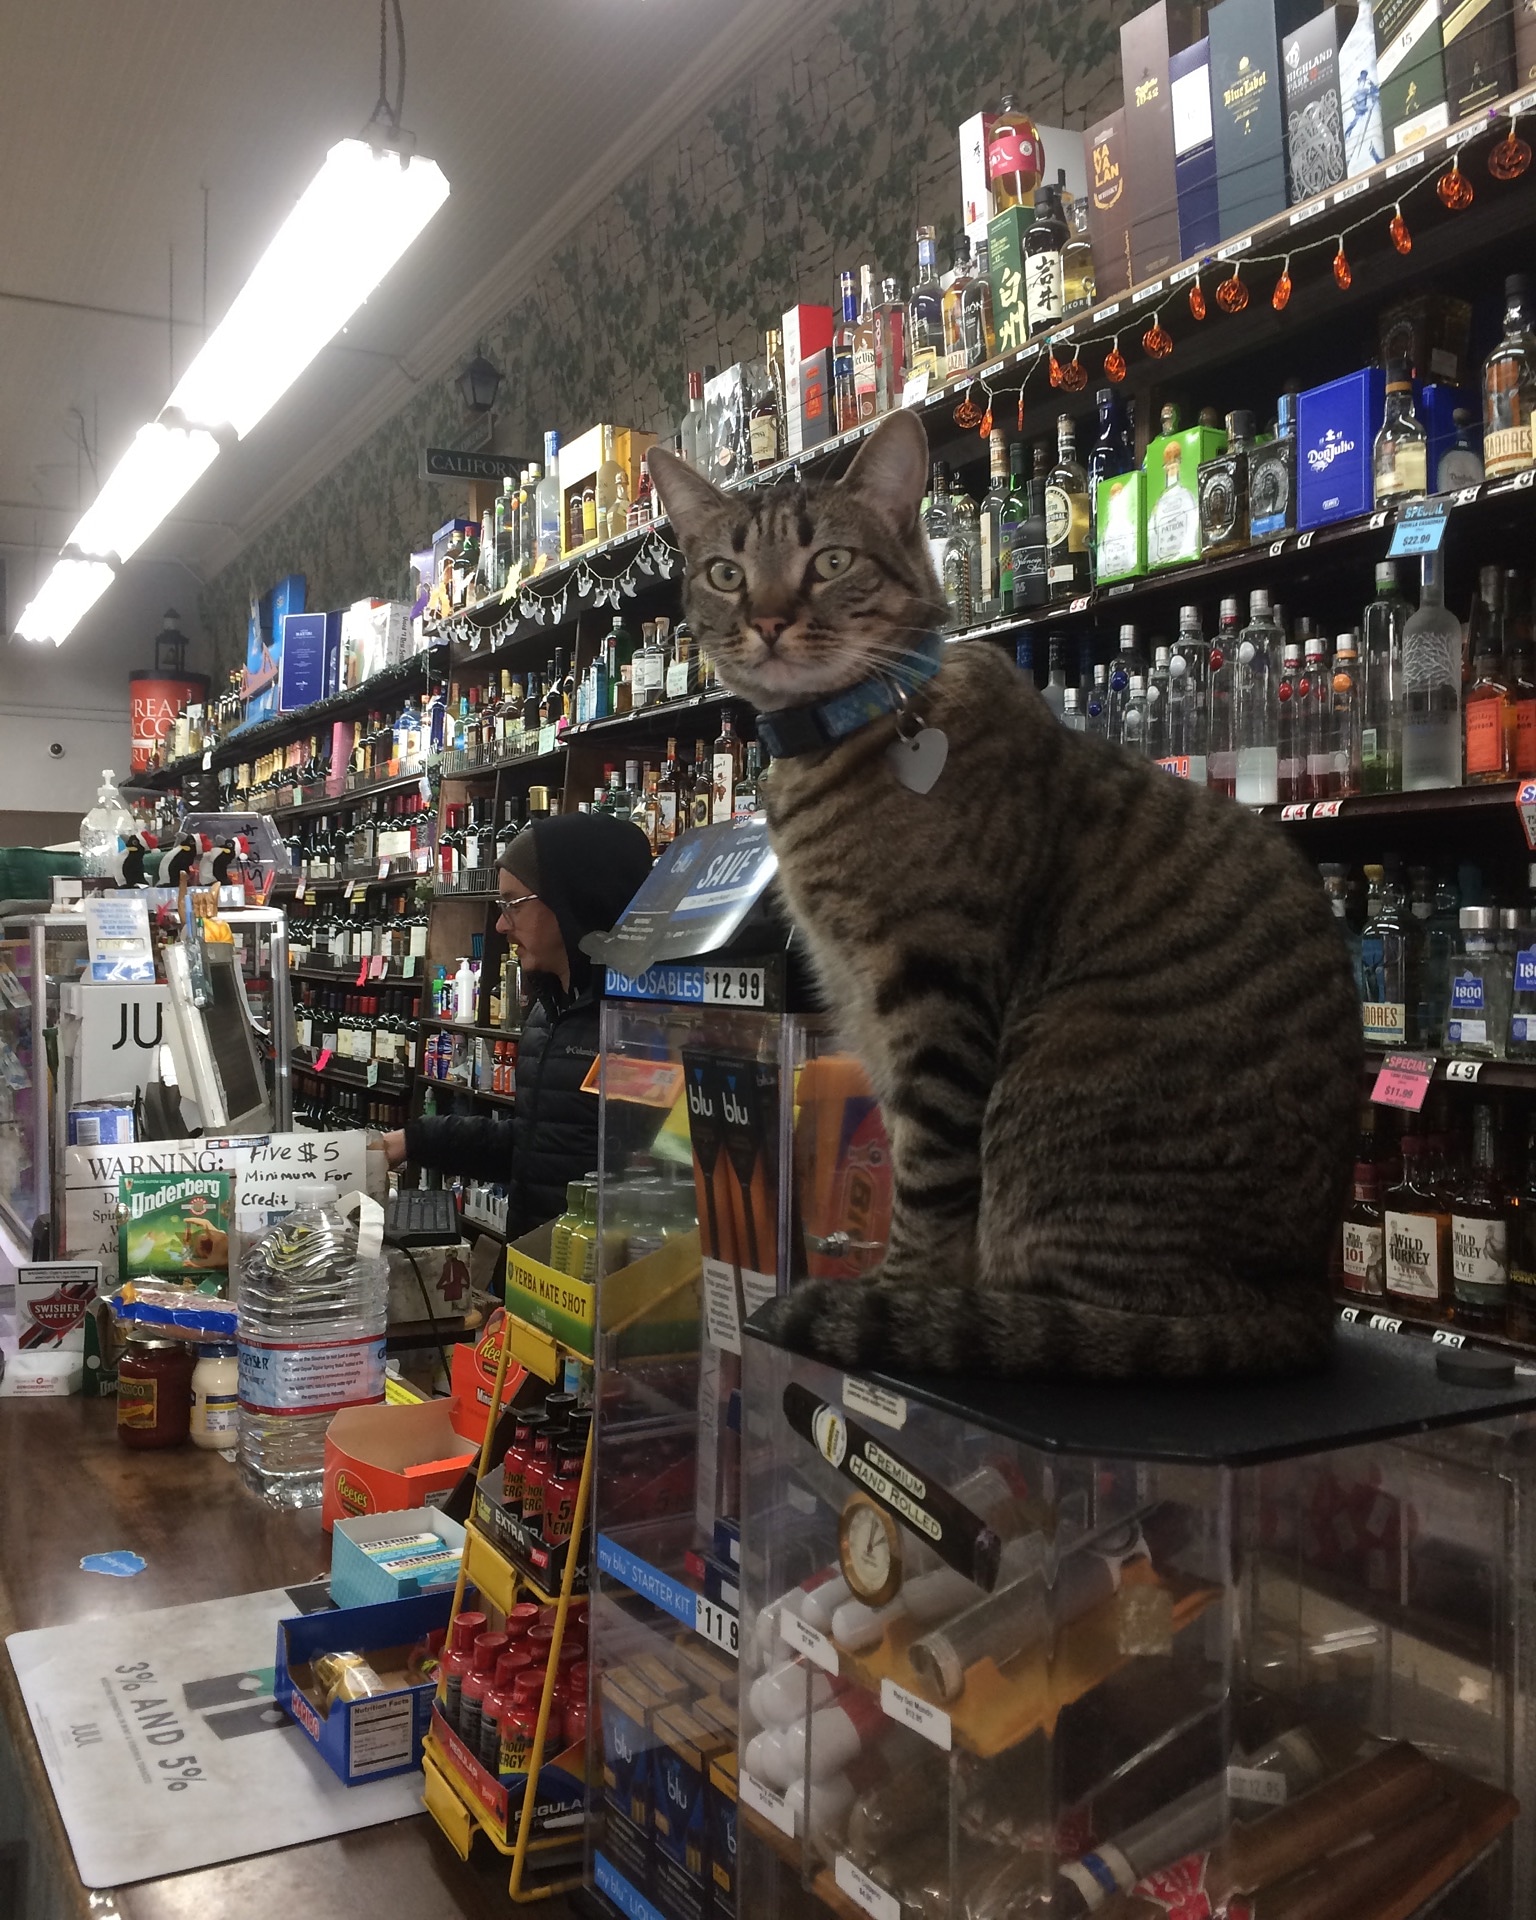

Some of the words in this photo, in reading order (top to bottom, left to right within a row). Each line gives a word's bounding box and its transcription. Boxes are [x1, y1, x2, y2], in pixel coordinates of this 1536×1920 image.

[1401, 33, 1413, 47] 15
[1286, 48, 1333, 82] HIGHLAND
[1223, 83, 1243, 107] Blue
[1242, 71, 1267, 98] Label
[1286, 74, 1310, 93] PARK
[1033, 255, 1058, 311] 岩井
[999, 267, 1027, 352] 白州
[430, 455, 521, 478] CALIFORN
[1404, 501, 1444, 519] SPECIAL
[1313, 801, 1338, 817] 24
[696, 847, 760, 890] SAVE
[606, 966, 701, 998] DISPOSABLES
[704, 971, 760, 1001] $12.99
[1455, 985, 1482, 1001] 1800
[112, 1001, 163, 1051] JU
[1388, 1054, 1427, 1073] SPECIAL
[1451, 1063, 1476, 1079] 19
[689, 1084, 714, 1117] blu
[1384, 1085, 1414, 1099] $11.99
[723, 1092, 749, 1126] blu
[88, 1150, 225, 1180] WARNING:
[250, 1143, 292, 1164] Five
[245, 1169, 317, 1183] Minimum
[323, 1171, 353, 1182] For
[130, 1177, 221, 1220] Underberg
[1394, 1234, 1424, 1251] WILD
[1453, 1231, 1476, 1247] WILD
[1345, 1247, 1364, 1264] 101
[1389, 1244, 1431, 1266] TURKEY
[1455, 1262, 1475, 1275] RYE
[514, 1267, 537, 1292] YERBA
[539, 1279, 560, 1305] MATE
[562, 1290, 587, 1318] SHOT
[34, 1303, 80, 1314] SWISHER
[38, 1311, 78, 1319] SWEETS
[867, 1443, 924, 1495] PREMIUM
[337, 1473, 368, 1509] Reese's
[851, 1459, 887, 1495] HAND
[889, 1487, 942, 1538] ROLLED
[357, 1535, 422, 1550] LISTERINE
[495, 1509, 525, 1546] EXTRA
[386, 1550, 455, 1568] LISTERINE
[631, 1565, 674, 1606] STARTER
[674, 1593, 691, 1615] KIT
[696, 1599, 739, 1650] $11.9
[115, 1661, 150, 1692] 3%
[291, 1689, 320, 1743] HARIBO
[354, 1703, 388, 1715] Nutrition
[388, 1698, 410, 1709] Facts
[131, 1698, 185, 1747] AND
[613, 1727, 633, 1764] blu
[158, 1756, 208, 1793] 5%
[667, 1770, 688, 1810] blu
